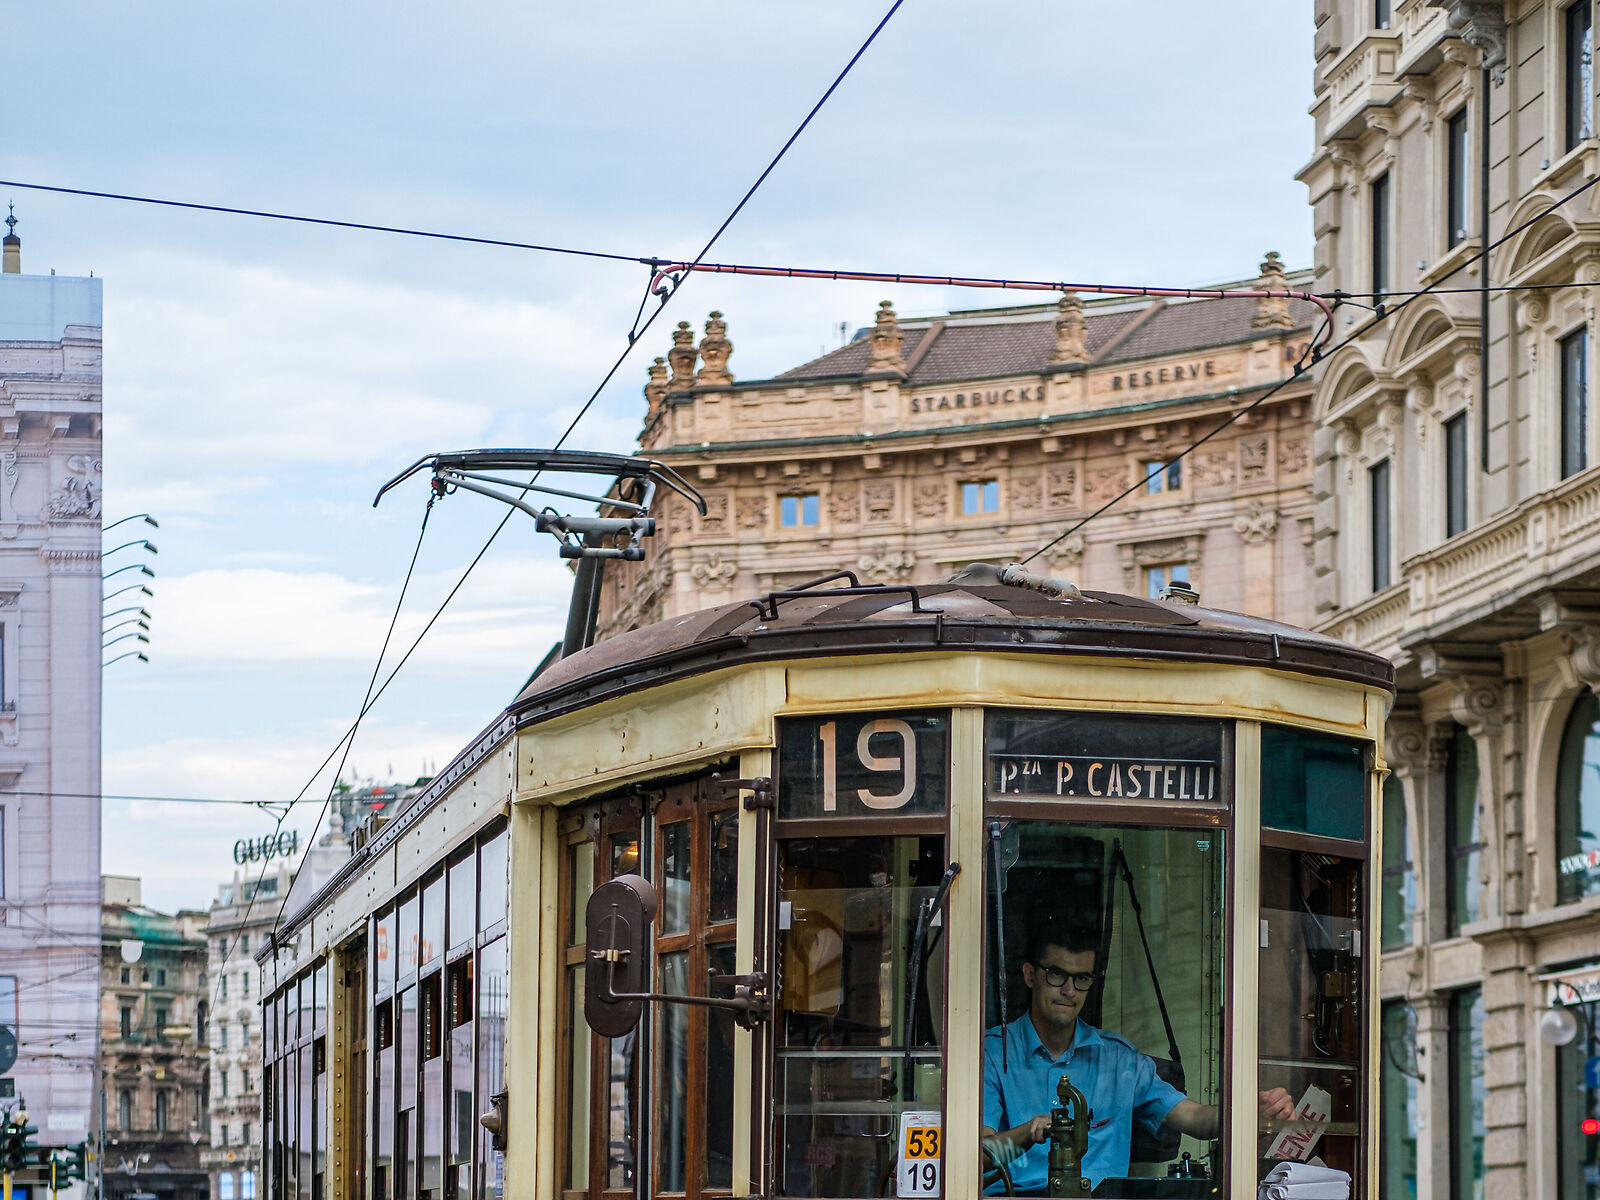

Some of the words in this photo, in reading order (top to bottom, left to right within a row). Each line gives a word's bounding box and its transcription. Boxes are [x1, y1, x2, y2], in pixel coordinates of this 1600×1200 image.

[911, 385, 1047, 413] STARBUCKS
[1112, 360, 1217, 391] RESERVE
[819, 719, 917, 811] 19
[1086, 762, 1216, 801] CASTELLI
[233, 829, 298, 866] GUCCI
[908, 1129, 938, 1157] 53
[907, 1162, 937, 1191] 19
